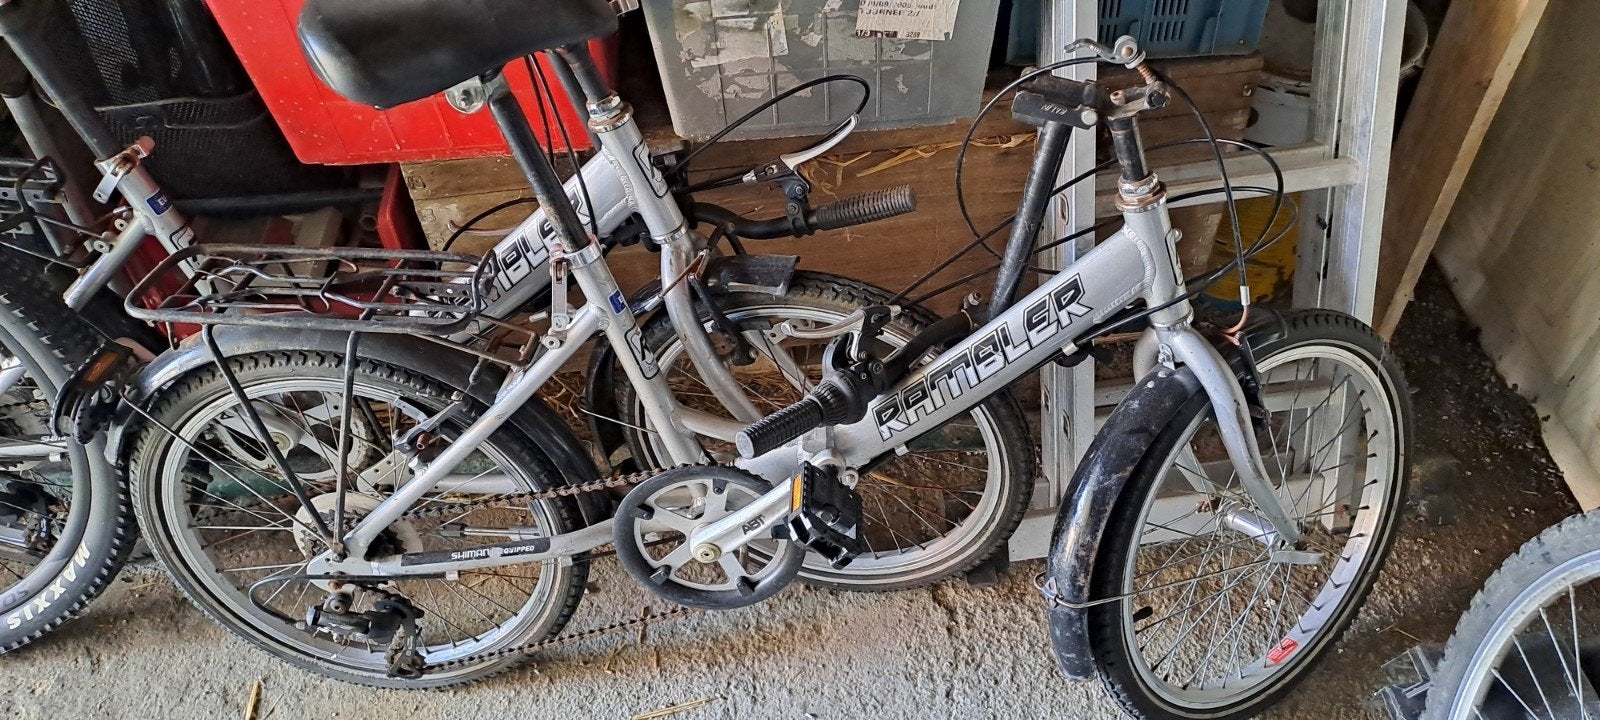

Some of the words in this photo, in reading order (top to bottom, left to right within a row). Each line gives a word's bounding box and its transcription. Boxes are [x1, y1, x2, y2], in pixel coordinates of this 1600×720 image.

[872, 272, 1094, 442] RAMBLER
[451, 547, 493, 560] SHIMAN
[500, 545, 535, 555] QUIPPED
[742, 514, 766, 536] ABT
[6, 540, 91, 630] MAXXIS
